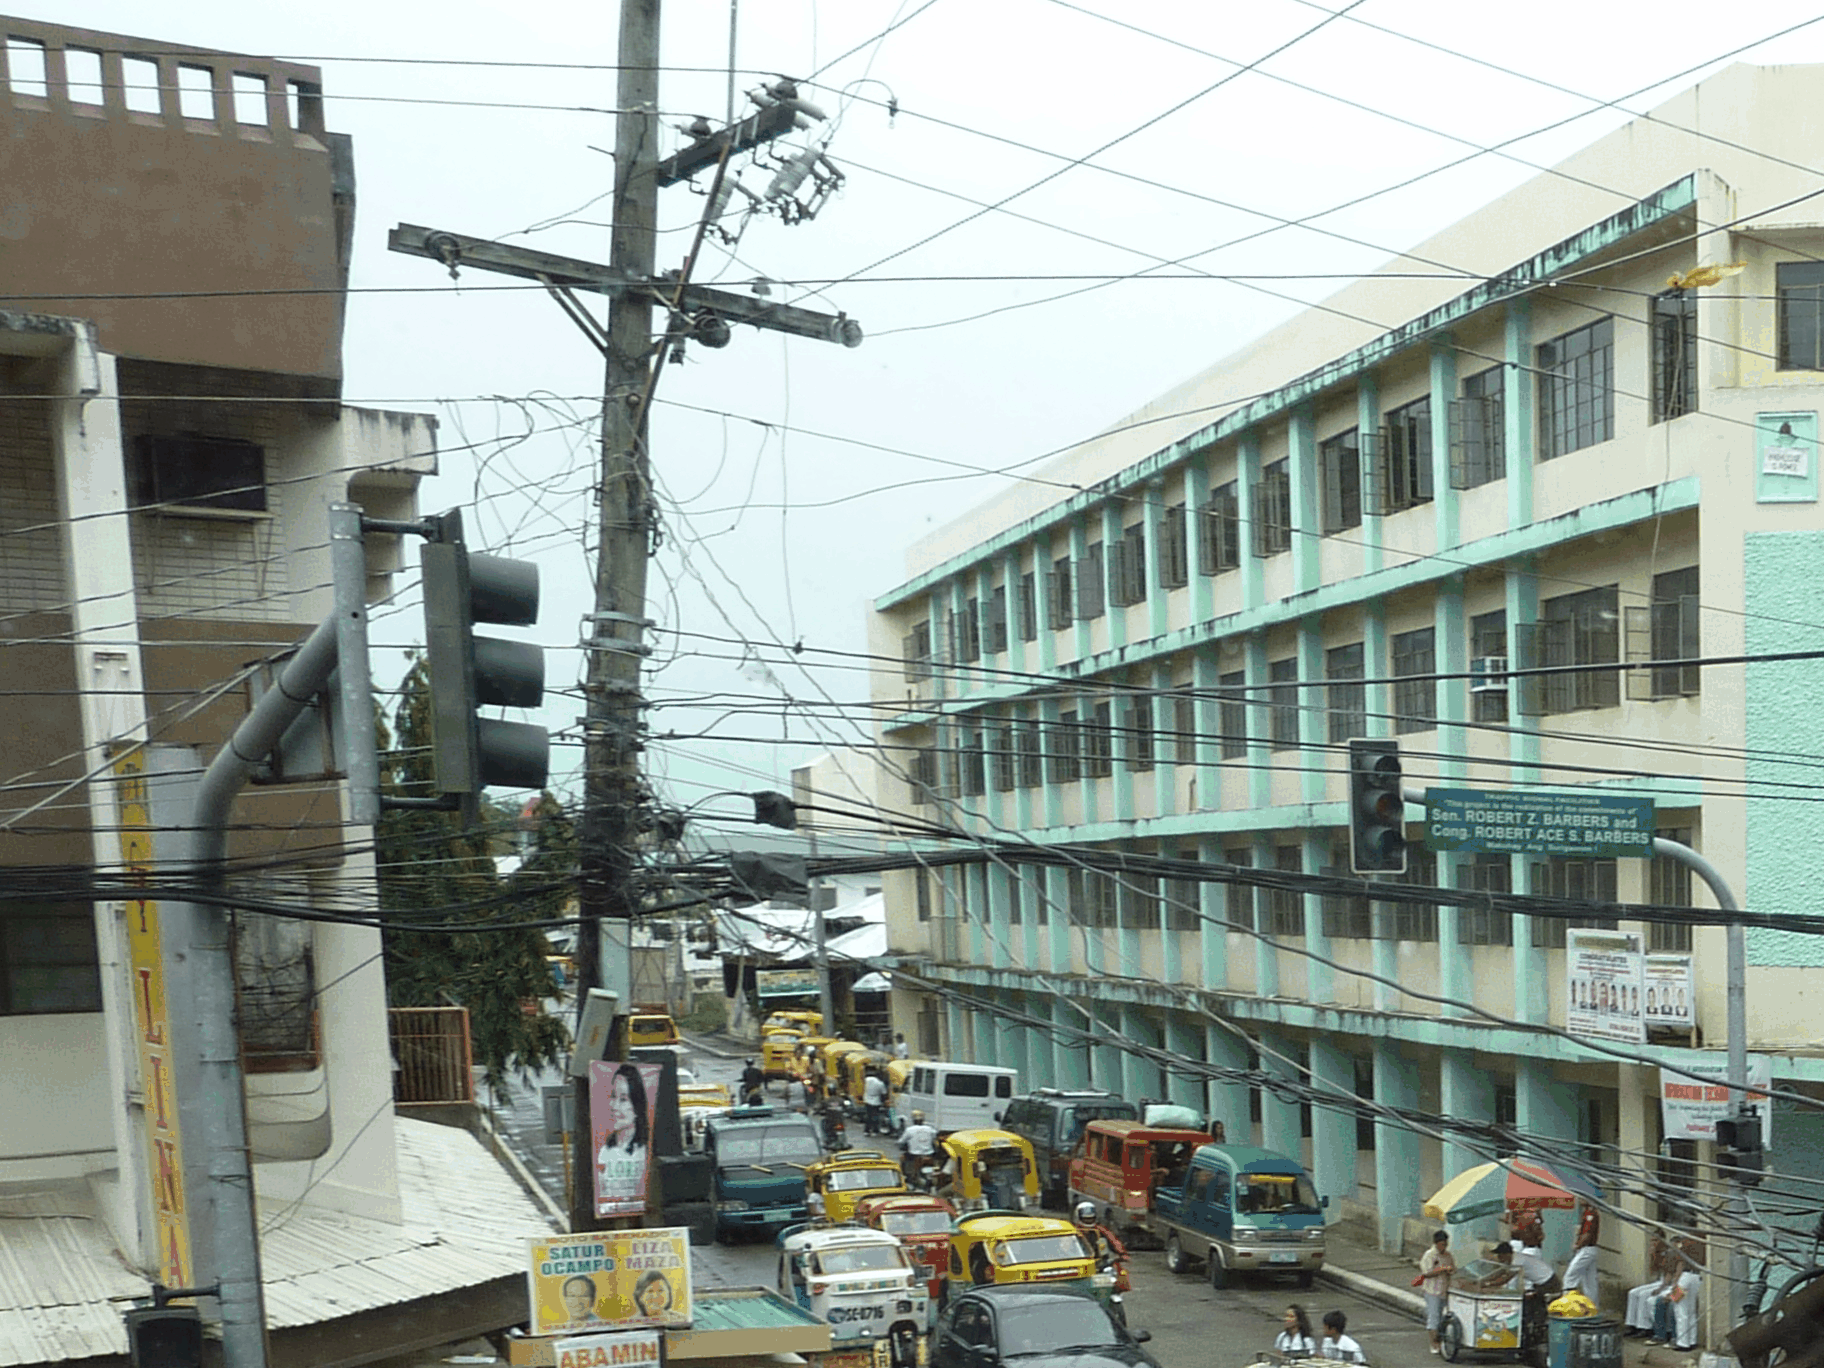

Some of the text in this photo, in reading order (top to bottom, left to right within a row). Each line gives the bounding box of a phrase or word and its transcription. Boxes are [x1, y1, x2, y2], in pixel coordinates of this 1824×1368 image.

[1431, 807, 1462, 821] Sen.
[1465, 809, 1523, 824] ROBERT
[1543, 813, 1609, 828] BARBERS
[1613, 816, 1637, 829] and
[1431, 823, 1471, 840] Cong.
[1474, 825, 1532, 840] ROBERT
[1536, 828, 1565, 841] ACE
[1584, 829, 1650, 844] BARBERS
[549, 1241, 672, 1260] SATUR LIZA
[541, 1255, 680, 1275] OCAMPO MAZA
